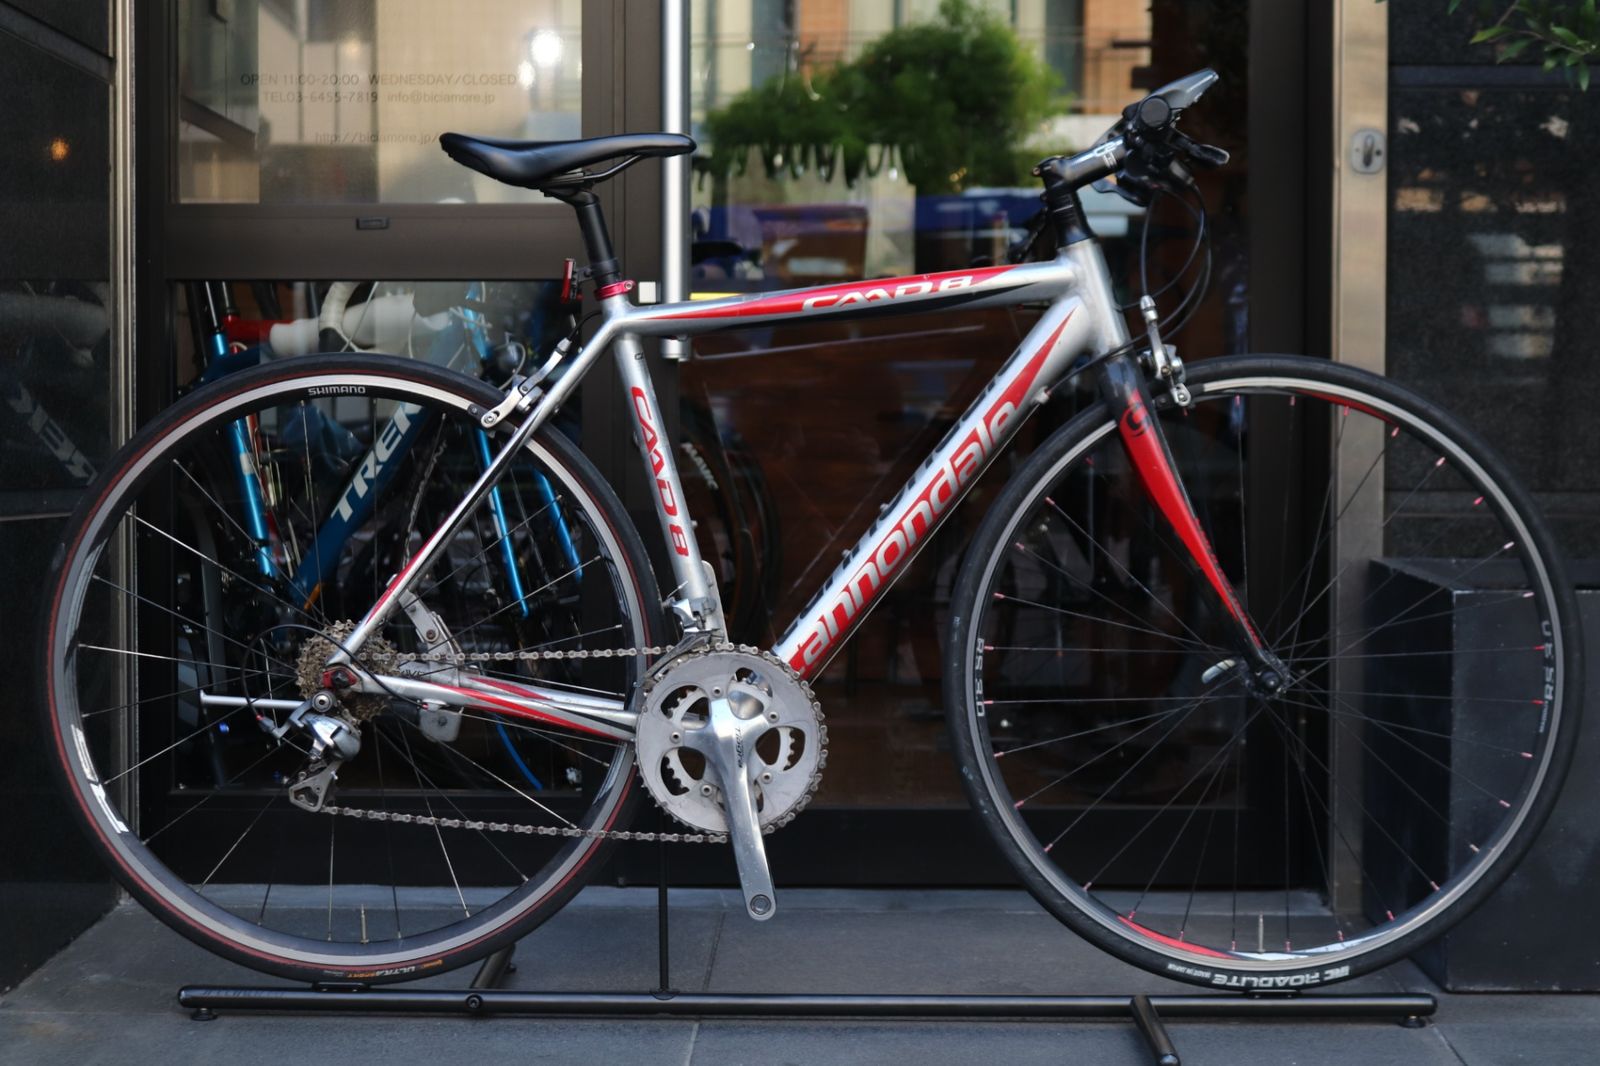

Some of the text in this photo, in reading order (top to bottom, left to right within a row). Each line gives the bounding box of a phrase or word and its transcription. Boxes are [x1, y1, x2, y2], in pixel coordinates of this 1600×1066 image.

[240, 73, 517, 86] OPEN 11:00-20:00 WEDNESDAY/CLOSED
[387, 90, 496, 104] info@biciamore.jp
[307, 385, 367, 396] SHIMANO
[797, 400, 1018, 674] annondale
[375, 966, 416, 976] ULTRA
[1212, 971, 1321, 988] ROADLITE
